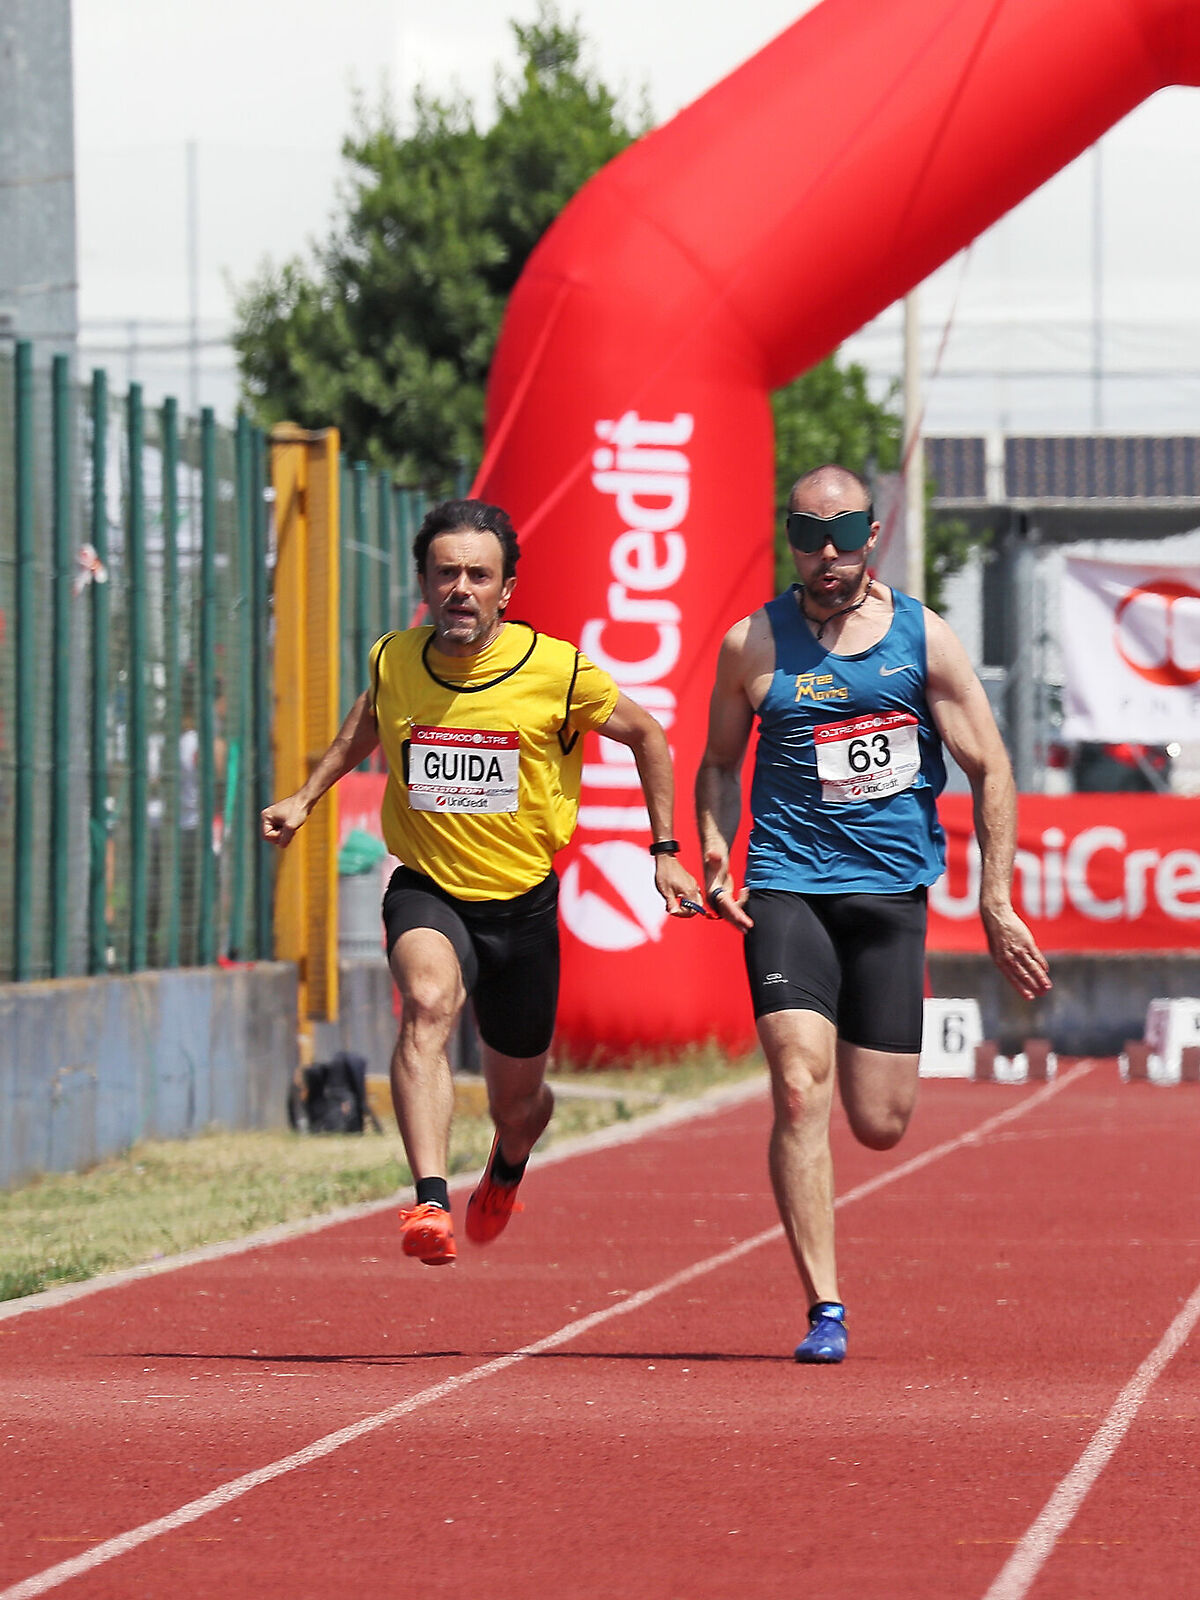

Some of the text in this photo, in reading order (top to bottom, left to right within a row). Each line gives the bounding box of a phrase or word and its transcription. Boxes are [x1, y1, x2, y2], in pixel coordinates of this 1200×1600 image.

[424, 751, 504, 782] GUIDA
[848, 733, 891, 773] 63
[447, 797, 488, 808] UniCredit
[942, 1014, 965, 1054] 6
